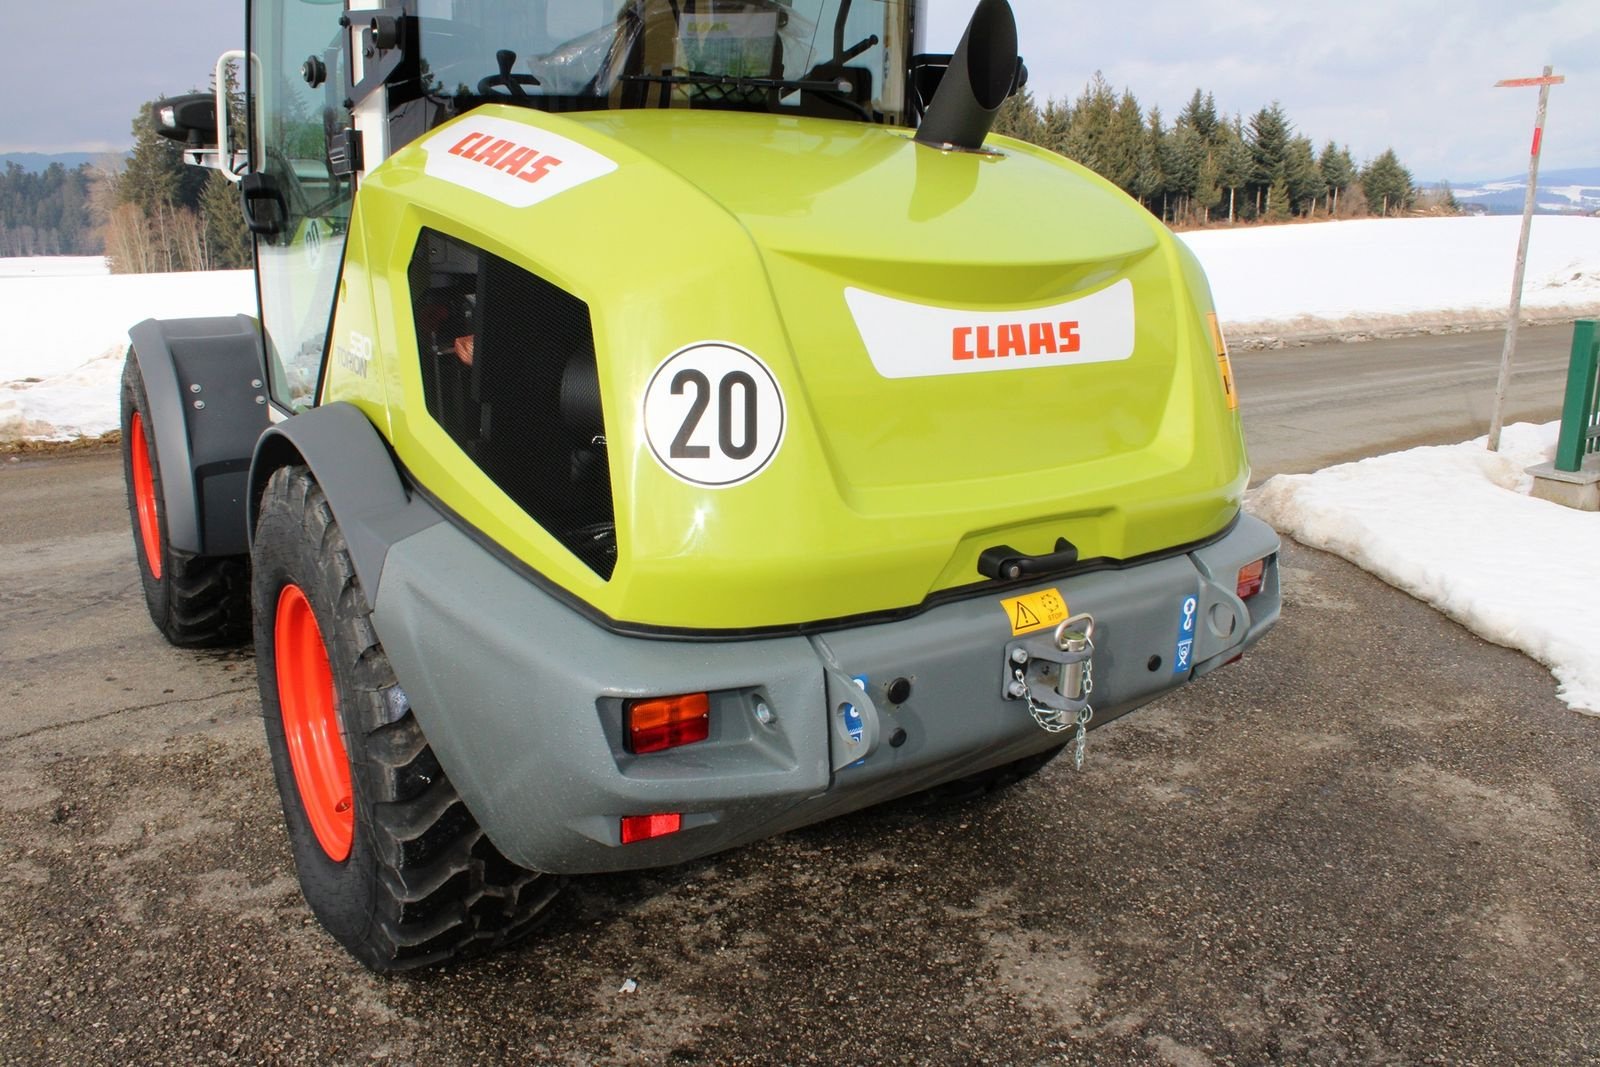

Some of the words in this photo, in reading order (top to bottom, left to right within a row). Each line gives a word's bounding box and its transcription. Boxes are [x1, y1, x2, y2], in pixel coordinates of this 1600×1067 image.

[448, 132, 563, 183] CLAAS
[952, 321, 1080, 360] CLAAS
[336, 345, 367, 379] TORION
[669, 368, 758, 461] 20
[1047, 612, 1063, 622] STOP
